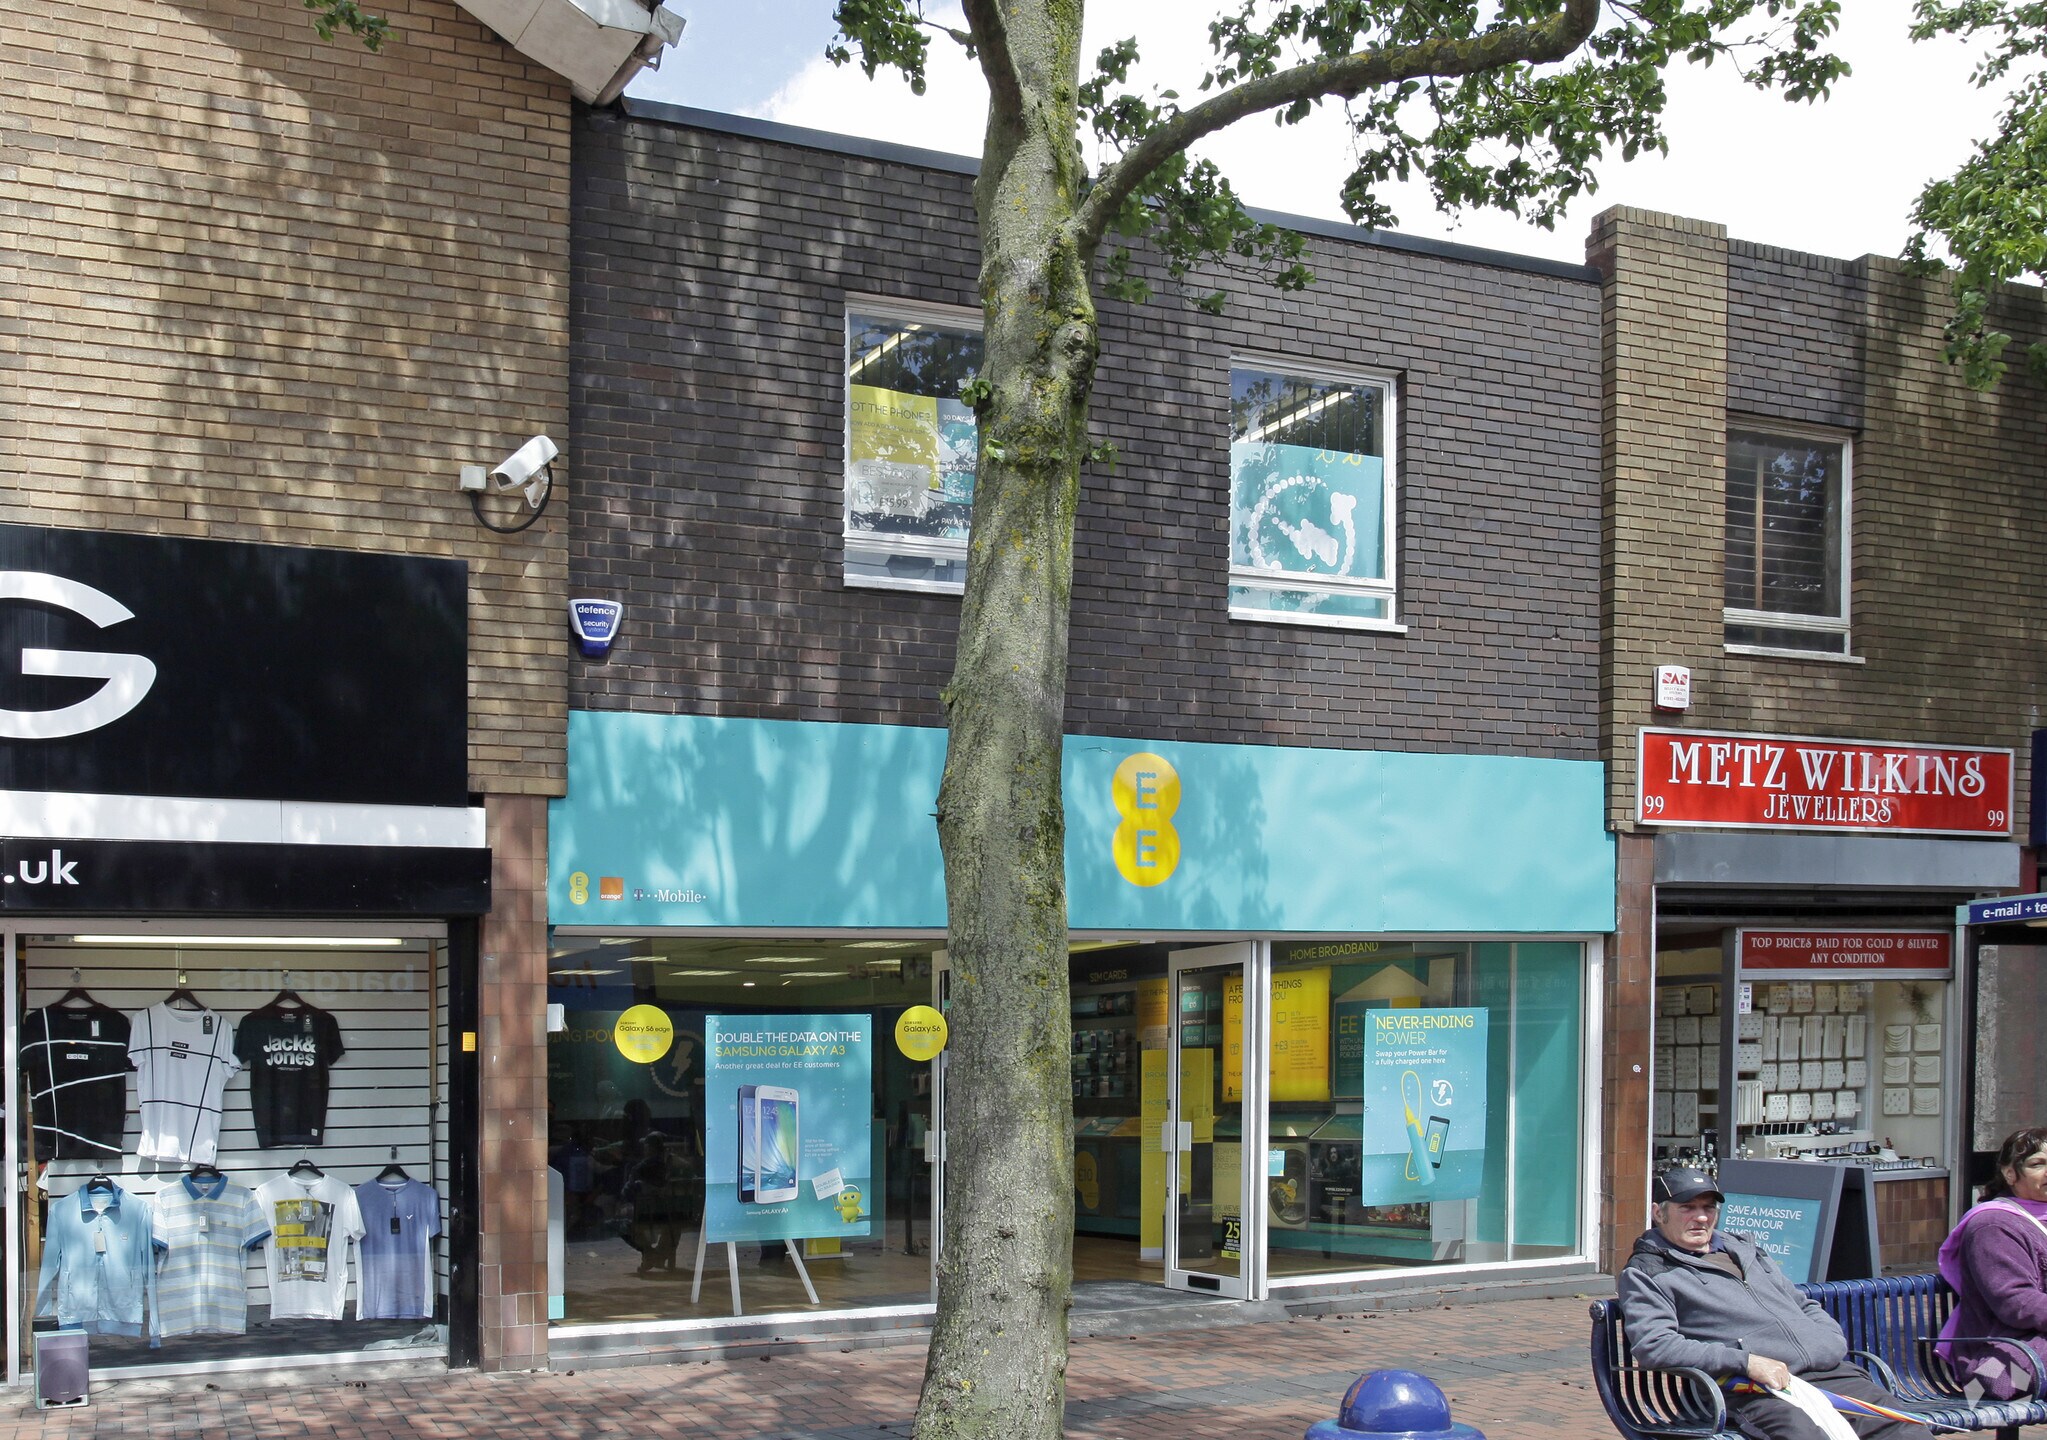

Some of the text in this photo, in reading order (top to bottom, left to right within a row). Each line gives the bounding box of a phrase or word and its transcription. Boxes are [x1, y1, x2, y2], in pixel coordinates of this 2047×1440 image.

[868, 402, 888, 416] THE
[889, 406, 932, 422] PHONE?
[577, 605, 616, 616] defence
[583, 620, 610, 629] security
[0, 570, 157, 739] G
[1668, 741, 1986, 798] METZ WILKINS
[1644, 795, 1665, 815] 99
[1763, 793, 1892, 824] JEWELLERS
[1987, 809, 2005, 827] 99
[3, 848, 81, 886] .uk
[600, 893, 623, 901] orange
[1982, 902, 2022, 919] e-mail
[1751, 937, 1939, 949] TOP PRICES PAID FOR GOLD & SILVER
[1289, 941, 1379, 961] HOME BROADBAND
[1809, 952, 1886, 964] ANY CONDITION
[1088, 969, 1127, 983] SIM CARDS
[1228, 979, 1303, 994] A FE THINGS
[1228, 994, 1243, 1004] FRO
[619, 1025, 645, 1033] Galaxy
[654, 1026, 671, 1034] edge
[903, 1025, 931, 1034] Galaxy
[1339, 1014, 1358, 1035] EE
[1375, 1015, 1474, 1030] NEVER-ENDING
[263, 1033, 317, 1054] Jack&
[715, 1031, 862, 1044] DOUBLE THE DATA ON THE
[1375, 1031, 1427, 1046] POWER
[715, 1044, 846, 1057] SAMSUNG GALAXY A3
[1375, 1050, 1393, 1059] Swap
[715, 1061, 840, 1071] Another great deal for EE customers
[1380, 1058, 1394, 1066] fully
[1394, 1058, 1420, 1066] charged
[1432, 1057, 1446, 1065] here
[1726, 1204, 1803, 1221] SAVE A MASSIVE
[1225, 1221, 1240, 1239] 25
[1725, 1215, 1784, 1231] £215 ON OUR
